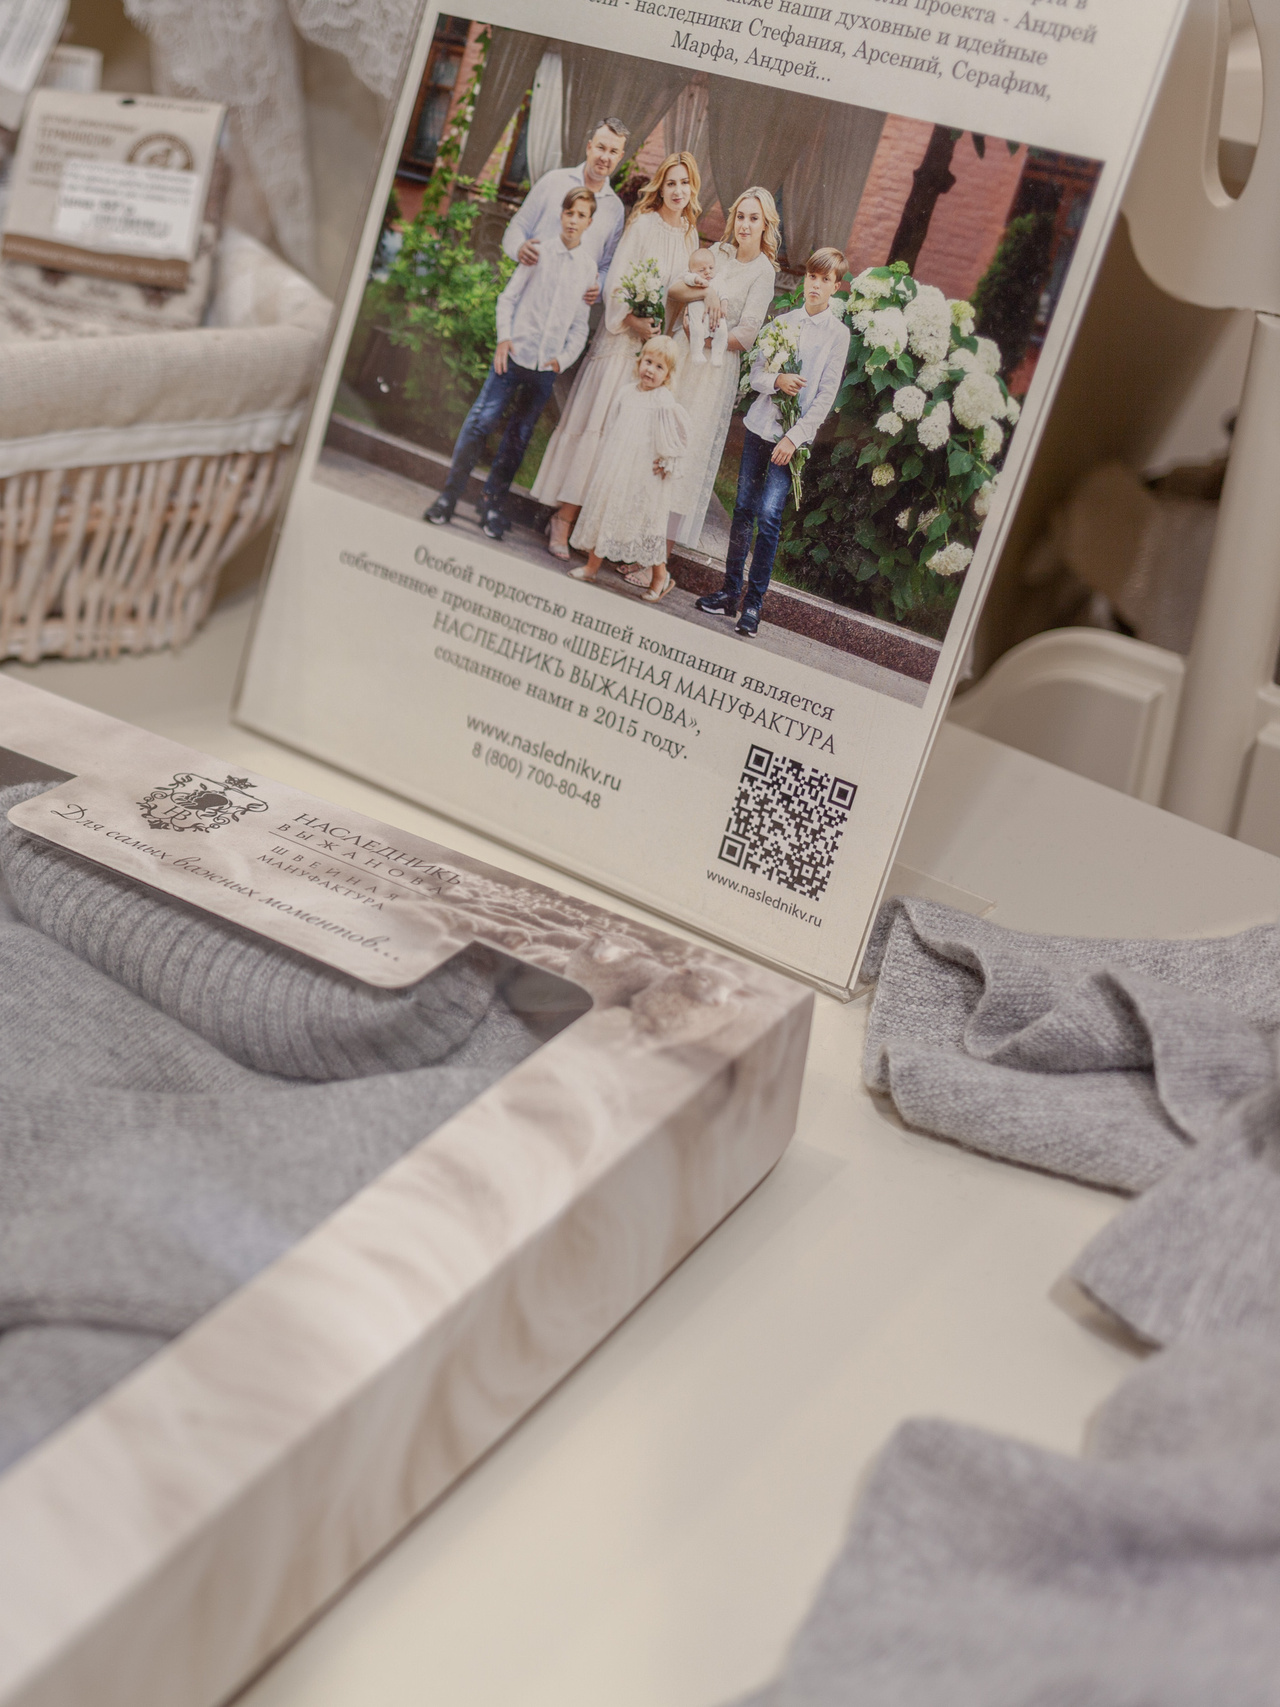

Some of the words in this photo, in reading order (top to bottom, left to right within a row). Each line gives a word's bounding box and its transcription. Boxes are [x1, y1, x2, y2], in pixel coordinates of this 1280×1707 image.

[634, 0, 743, 33] наследники
[748, 17, 846, 58] Стефания,
[851, 39, 943, 78] Арсений,
[951, 59, 1052, 101] Серафим,
[670, 30, 739, 64] Марфа,
[744, 47, 831, 82] Андрей...
[777, 0, 833, 22] наши
[835, 11, 931, 42] духовные
[936, 31, 951, 46] и
[956, 33, 1049, 66] идейные
[914, 0, 996, 24] проекта
[1014, 10, 1098, 44] Андрей
[339, 549, 438, 599] собственное
[441, 590, 558, 646] производство
[562, 634, 673, 690] «ШВЕЙНАЯ
[674, 676, 836, 755] МАНУФАКТУРА
[413, 544, 474, 583] Особой
[476, 573, 567, 619] гордостью
[571, 608, 635, 646] нашей
[639, 634, 737, 683] компании
[740, 674, 835, 721] является
[432, 610, 564, 679] НАСЛЕДНИКЪ
[570, 663, 701, 737] ВЫЖАНОВА»,
[434, 644, 521, 691] созданное
[525, 680, 574, 712] нами
[577, 704, 589, 718] в
[593, 706, 639, 738] 2015
[641, 728, 687, 760] году.
[466, 713, 622, 792] www.naslednikv.ru
[471, 741, 482, 758] 8
[484, 744, 523, 779] (800)
[526, 764, 601, 809] 700-80-48
[50, 803, 104, 832] Для
[106, 830, 172, 860] самых
[172, 856, 260, 897] важных
[258, 896, 399, 962] моментов...
[256, 854, 384, 911] МАНУФАКТУРА
[270, 845, 399, 901] ШВЕЙНАЯ
[276, 823, 442, 895] ВЫЖАНОВА
[292, 813, 461, 886] НАСЛЕДНИКЪ
[706, 869, 822, 928] www.naslednikv.ru
